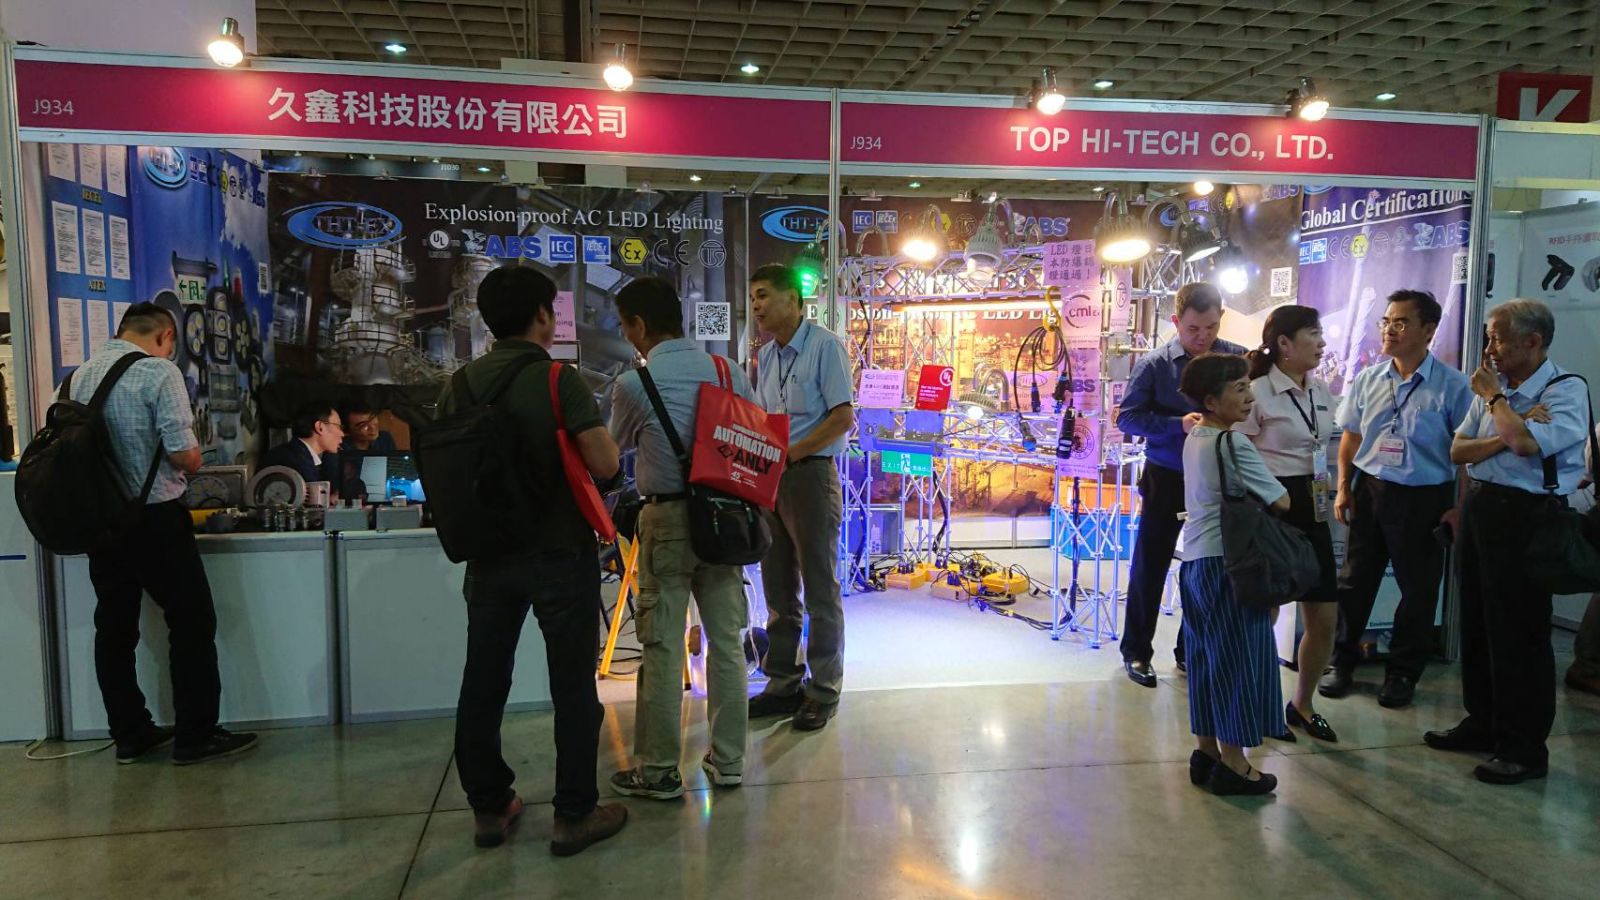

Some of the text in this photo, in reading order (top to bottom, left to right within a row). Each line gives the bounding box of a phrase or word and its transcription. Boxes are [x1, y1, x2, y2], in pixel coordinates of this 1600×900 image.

[32, 98, 75, 116] J934
[267, 87, 627, 139] 久鑫科技股份有限公司
[850, 135, 882, 152] J934
[1010, 125, 1334, 161] TOP HI-TECH CO., LTD.
[425, 202, 724, 234] Explosion-proof AC LED Lighting
[854, 214, 872, 226] IEC
[1300, 202, 1347, 231] Global
[433, 233, 445, 246] UL
[484, 234, 543, 260] ABS
[551, 240, 574, 253] IEC
[713, 424, 782, 464] AUTOMATION
